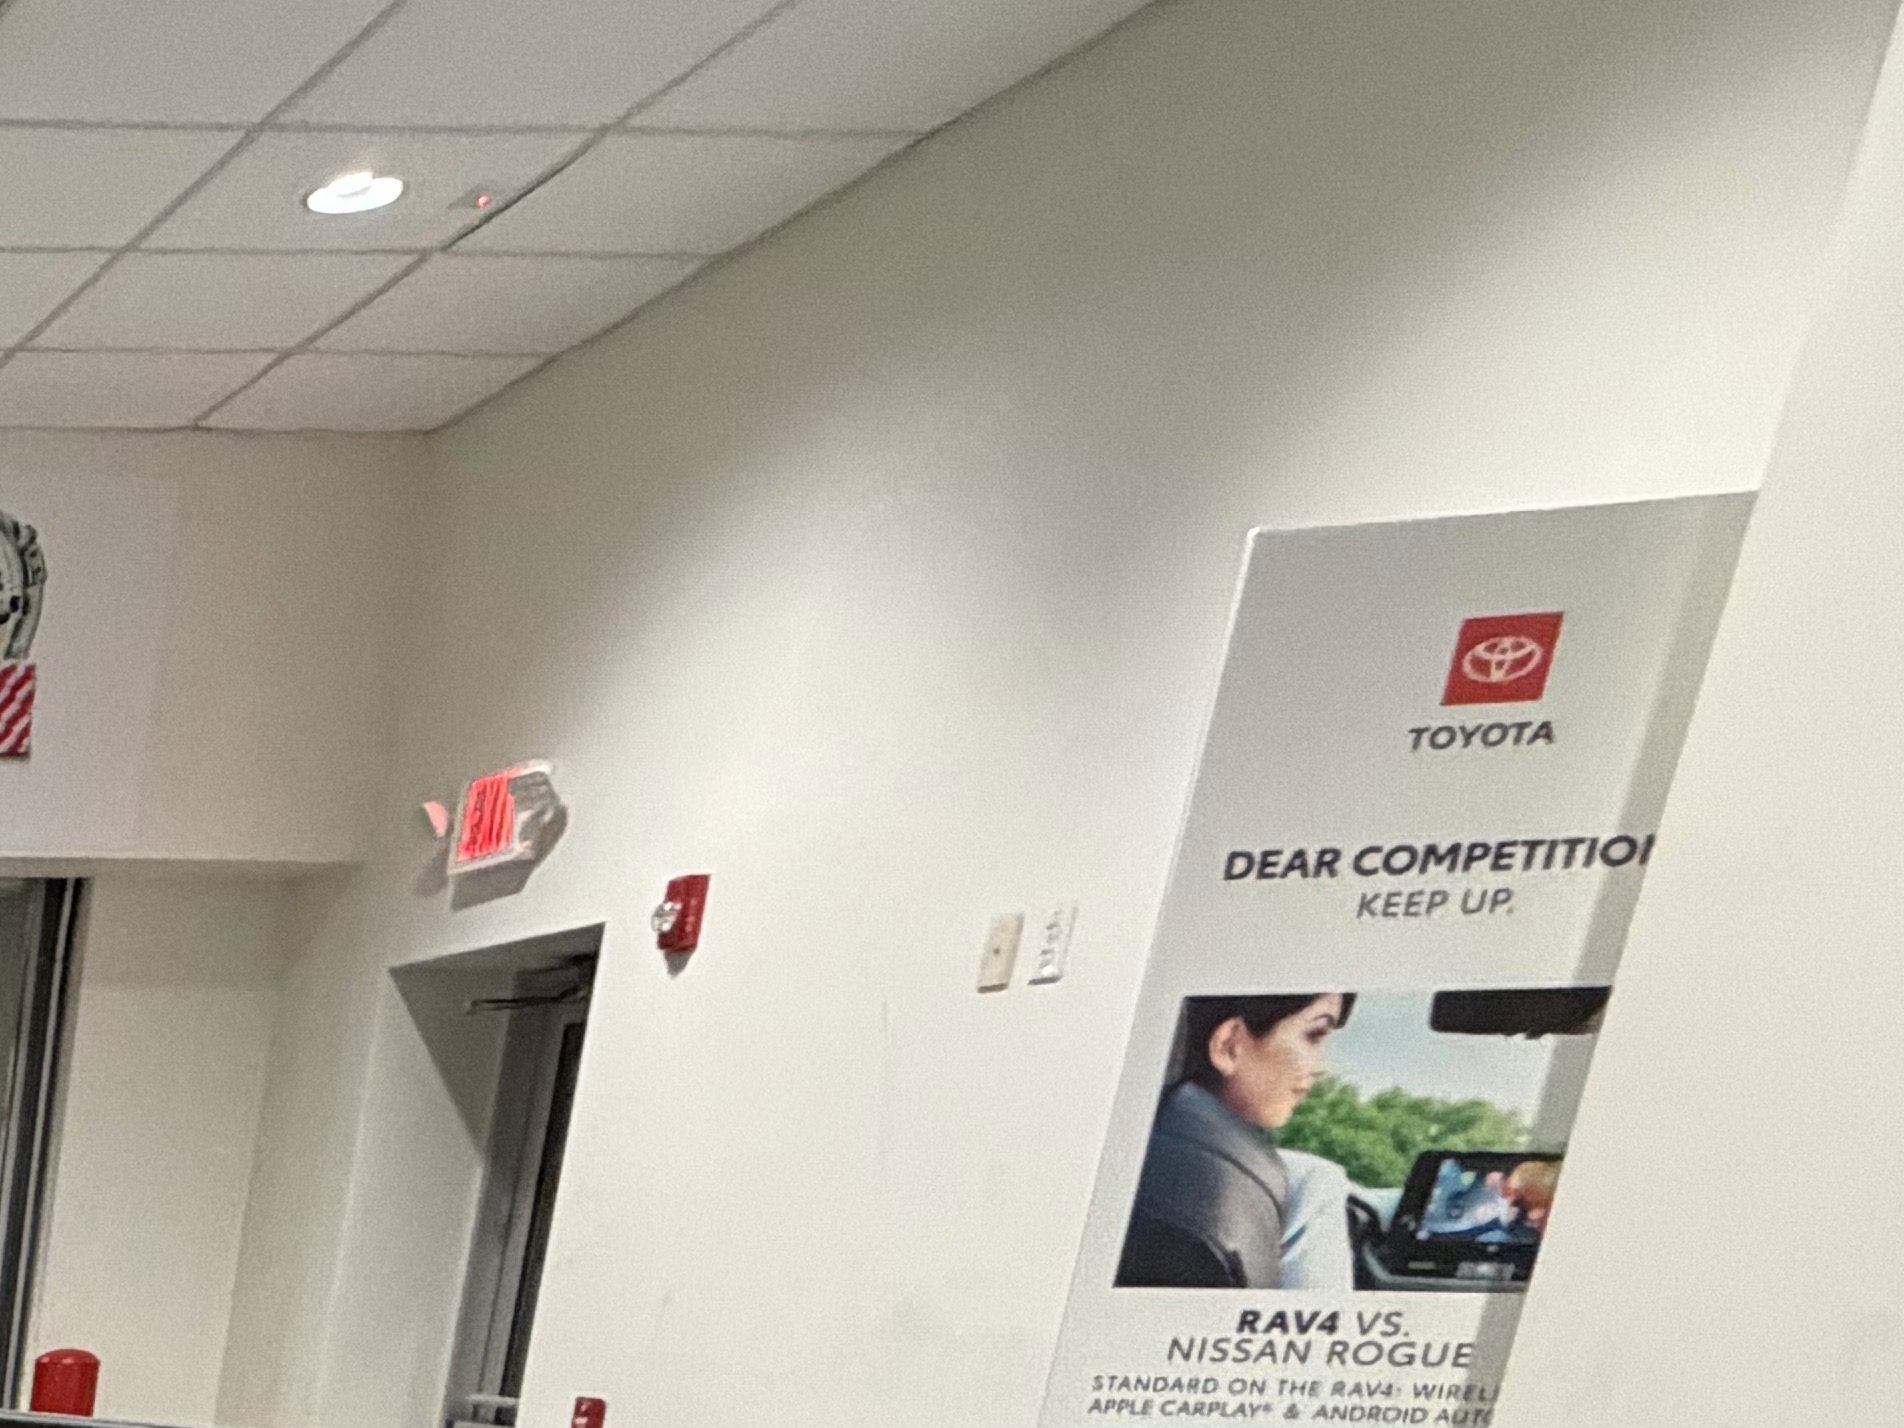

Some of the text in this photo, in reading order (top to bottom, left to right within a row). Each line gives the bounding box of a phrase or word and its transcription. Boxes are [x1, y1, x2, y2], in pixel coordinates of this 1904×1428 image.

[1408, 720, 1555, 752] TOYOTA
[1223, 846, 1342, 881] DEAR
[1356, 887, 1515, 918] KEEP UP.
[1236, 1310, 1410, 1337] RAV4 VS.
[1166, 1337, 1475, 1368] NISSAN ROGUE
[1091, 1375, 1218, 1395] STANDARD
[1228, 1378, 1267, 1396] ON
[1277, 1380, 1321, 1398] THE
[1087, 1399, 1153, 1417] APPLE
[1312, 1405, 1428, 1424] ANDROID
